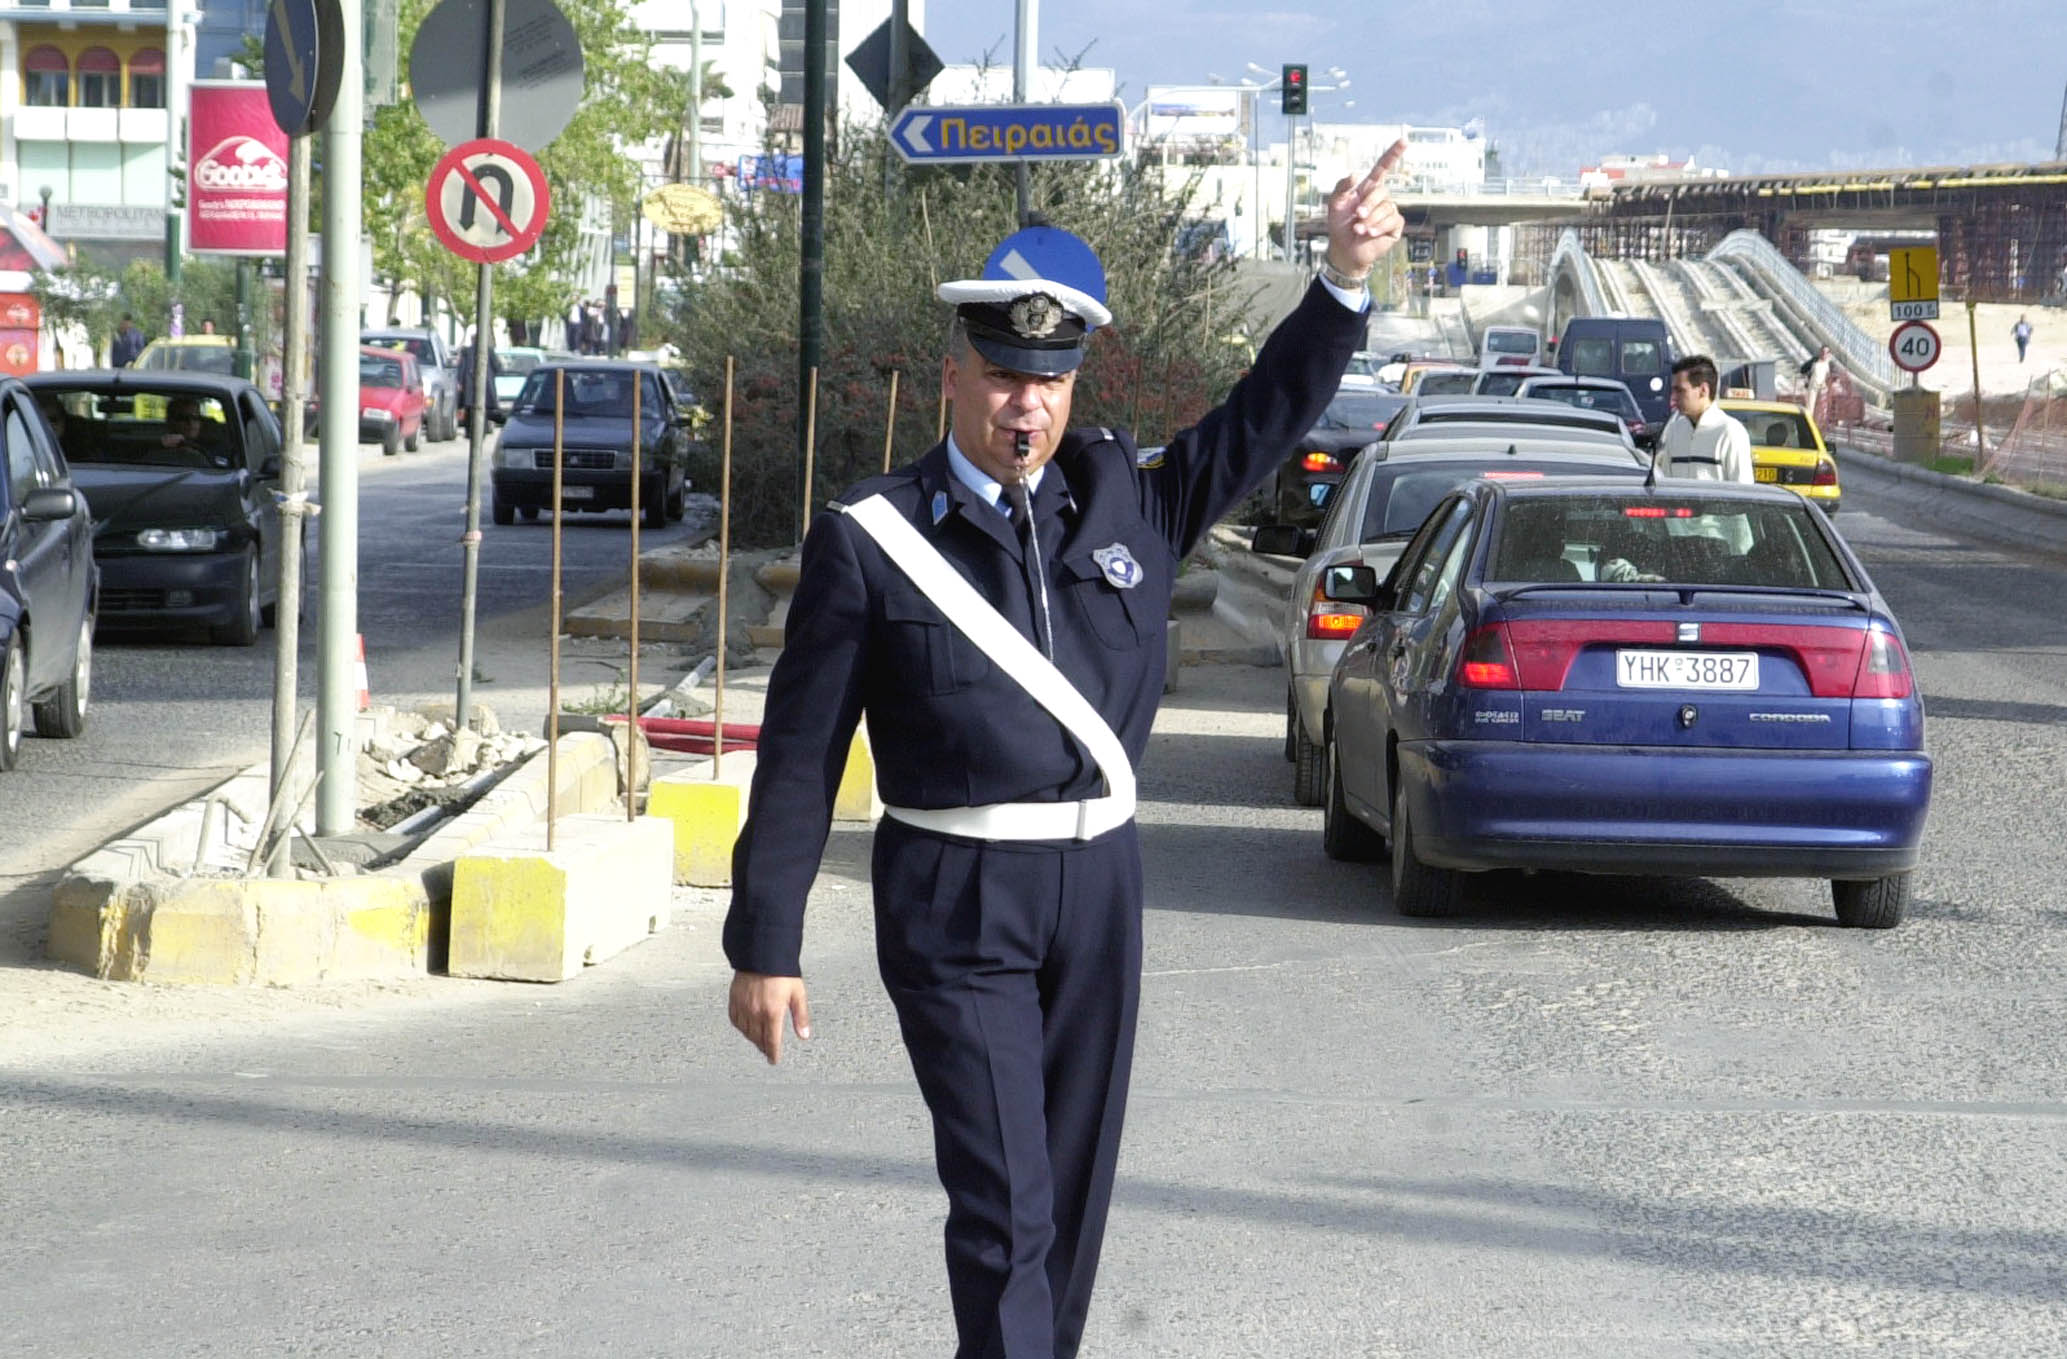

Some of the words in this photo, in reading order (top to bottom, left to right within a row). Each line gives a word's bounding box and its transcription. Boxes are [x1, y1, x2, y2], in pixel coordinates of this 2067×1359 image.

[941, 116, 1116, 153] Πειραιάς
[1898, 304, 1923, 317] 100
[1901, 337, 1930, 356] 40
[1541, 709, 1586, 722] SEAT
